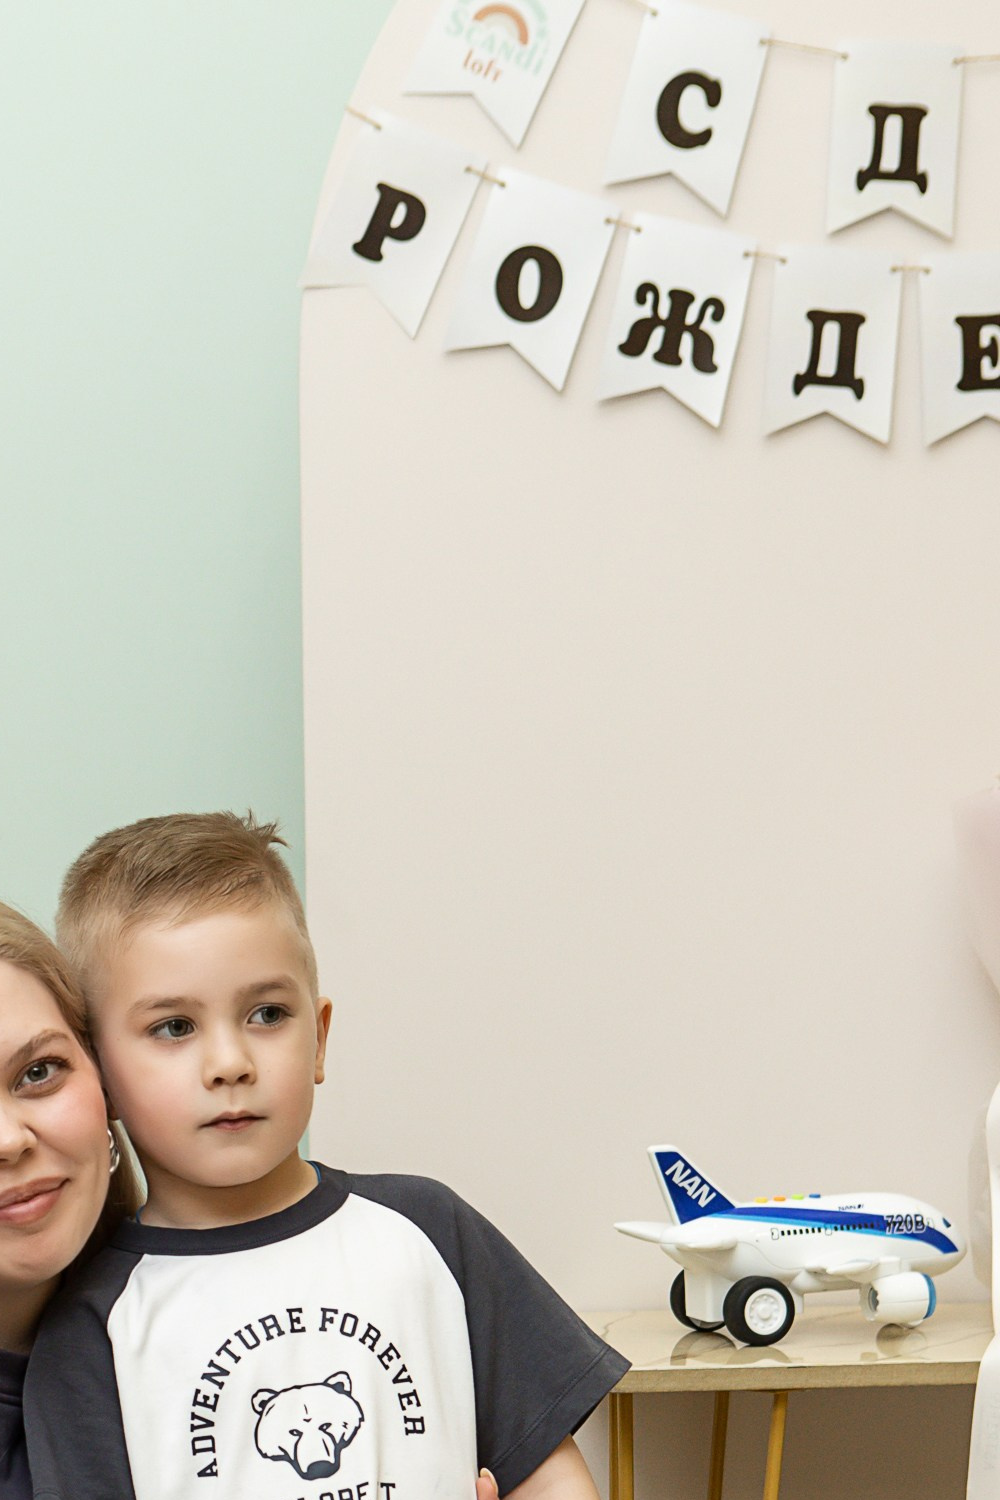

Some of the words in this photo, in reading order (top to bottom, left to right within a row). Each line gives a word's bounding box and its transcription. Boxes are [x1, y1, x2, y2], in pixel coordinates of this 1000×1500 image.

[656, 70, 722, 150] С
[856, 103, 929, 195] Д
[664, 1159, 717, 1208] NAN
[884, 1213, 926, 1235] 720B
[190, 1307, 306, 1478] ADVENTURE
[318, 1307, 426, 1436] FOREVER
